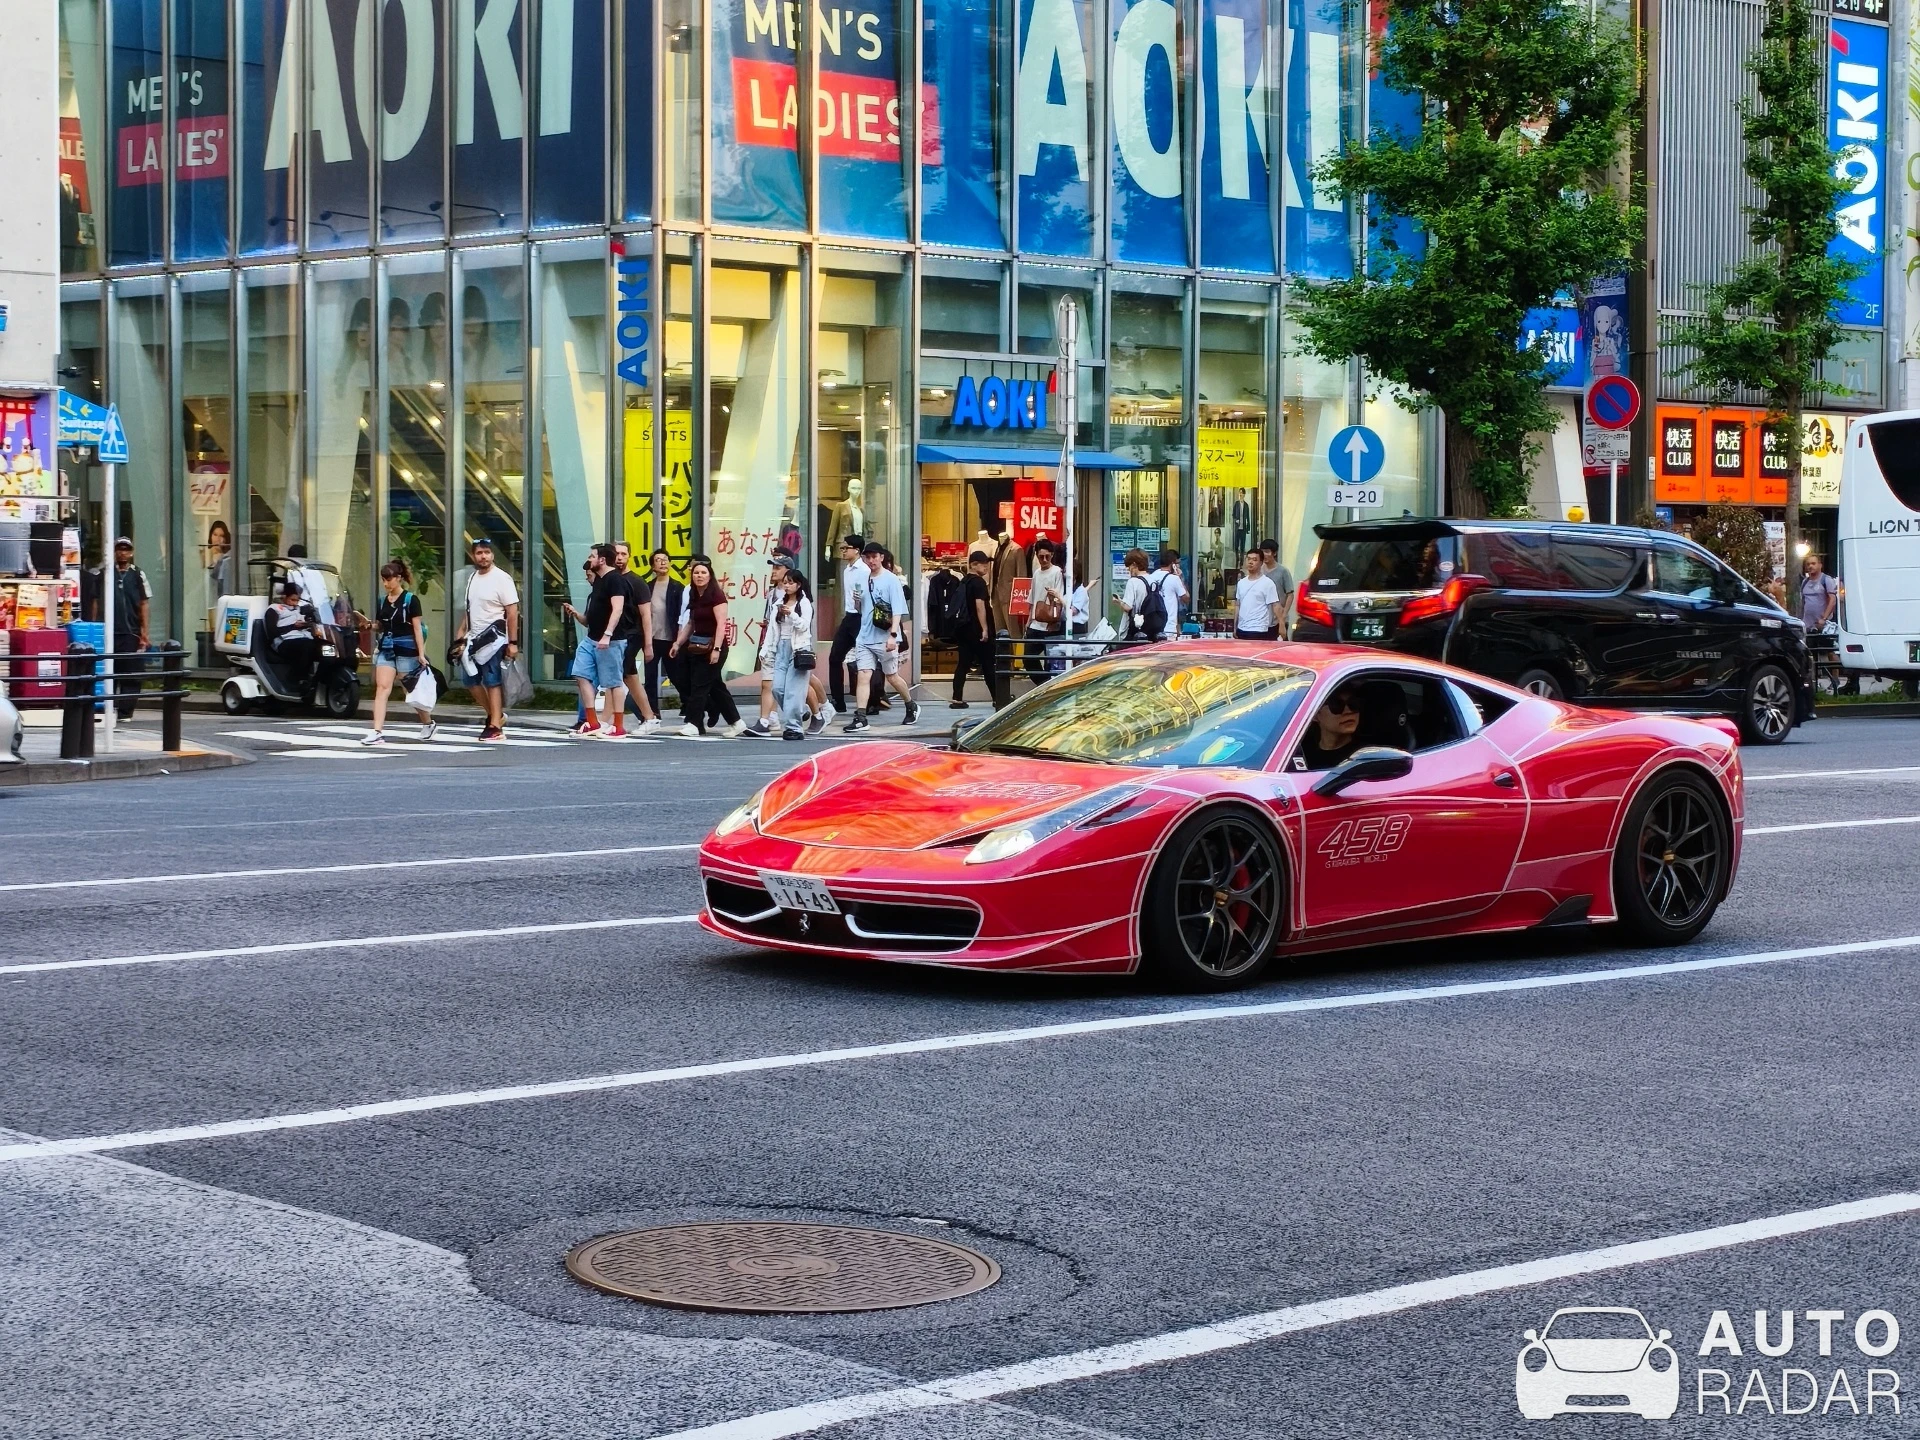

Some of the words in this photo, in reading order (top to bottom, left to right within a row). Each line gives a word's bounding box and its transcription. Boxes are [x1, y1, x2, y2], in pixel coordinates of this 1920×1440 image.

[745, 0, 882, 61] MEN'S
[128, 70, 203, 114] ME'S
[264, 0, 573, 170] AOKI
[1019, 0, 1343, 212] AOKI
[59, 138, 85, 160] ALE
[128, 129, 224, 173] LAIES'
[1836, 62, 1879, 254] AOKI
[617, 260, 649, 388] AOKI
[1865, 304, 1879, 320] 2F
[952, 375, 1047, 429] AOKI
[642, 430, 687, 441] STS
[1666, 428, 1692, 448] 快活
[1715, 430, 1741, 450] 快活
[1666, 452, 1692, 466] CLUB
[1715, 454, 1740, 468] CLUB
[1763, 456, 1787, 469] CLUB
[1020, 505, 1057, 530] SALE
[1869, 519, 1910, 534] LION
[1317, 814, 1413, 859] 458
